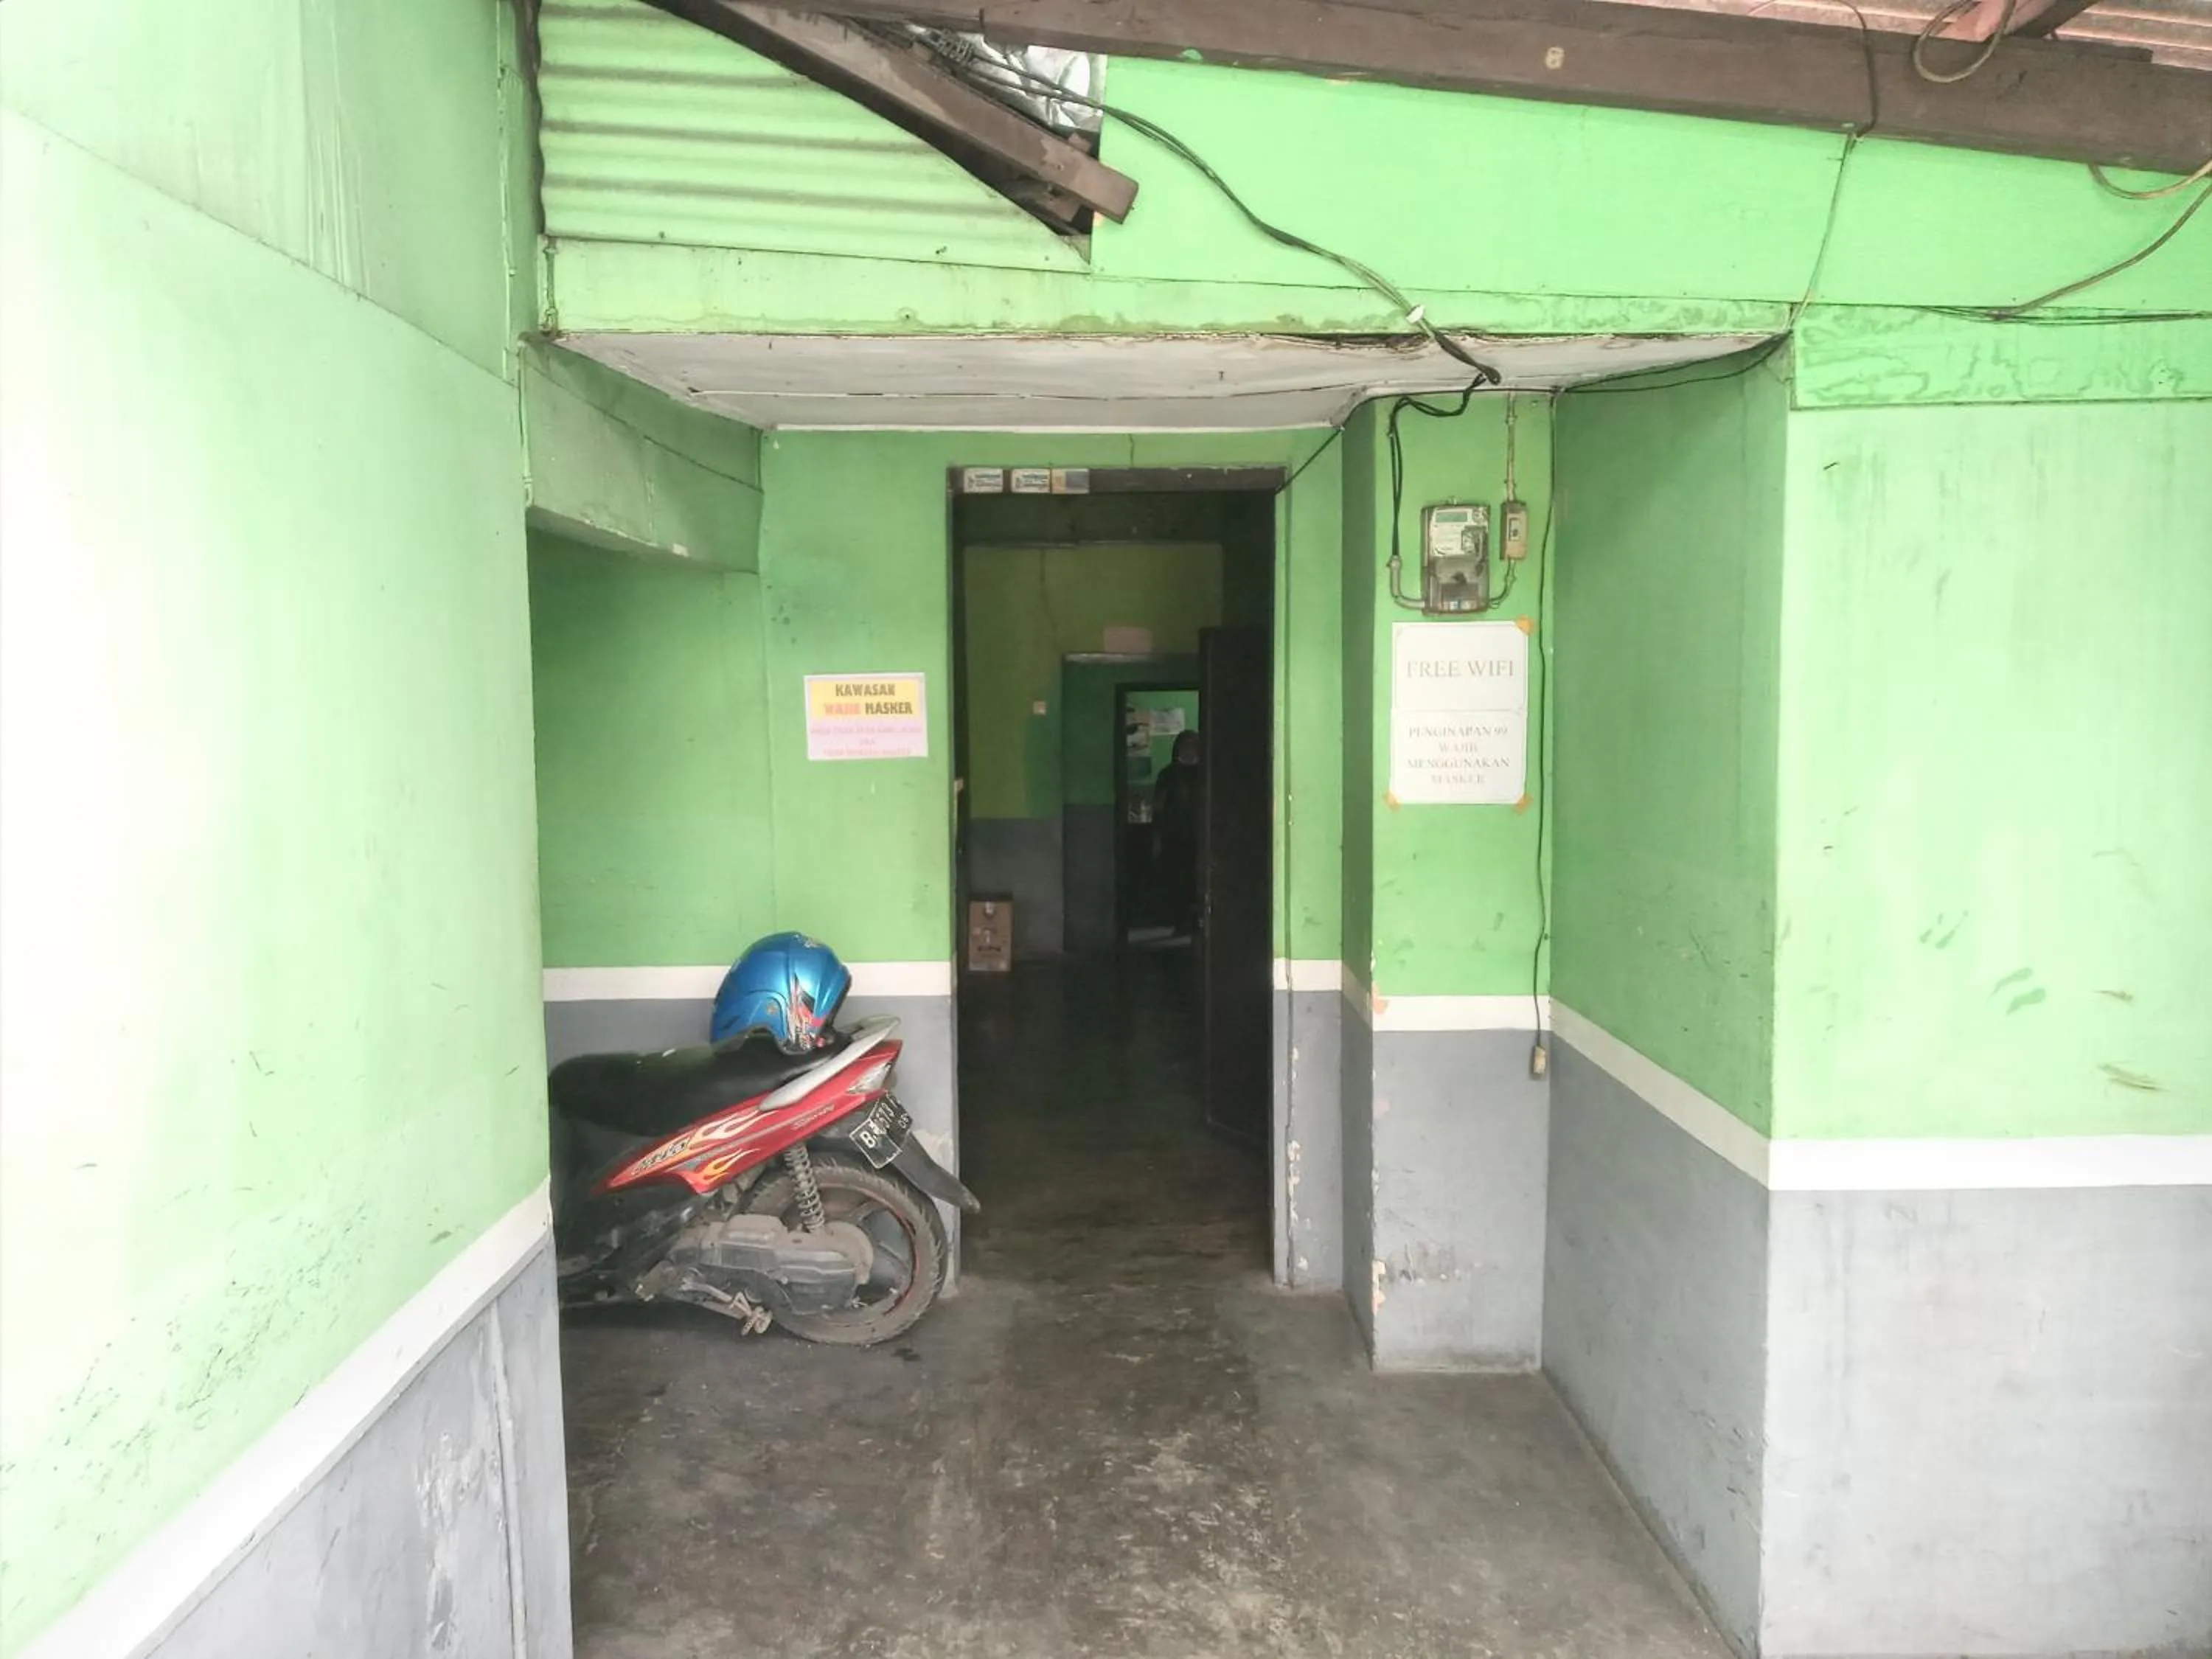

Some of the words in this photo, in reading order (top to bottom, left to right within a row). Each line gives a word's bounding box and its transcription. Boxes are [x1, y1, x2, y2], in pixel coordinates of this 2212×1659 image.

[1407, 660, 1461, 678] FREE
[1467, 660, 1514, 678] WIFI
[835, 684, 895, 696] KAWASAN
[865, 701, 913, 714] MASKER
[1408, 726, 1490, 737] PENGINAPAN
[1407, 757, 1510, 768] MENGGUNAKAN
[859, 1130, 877, 1148] B
